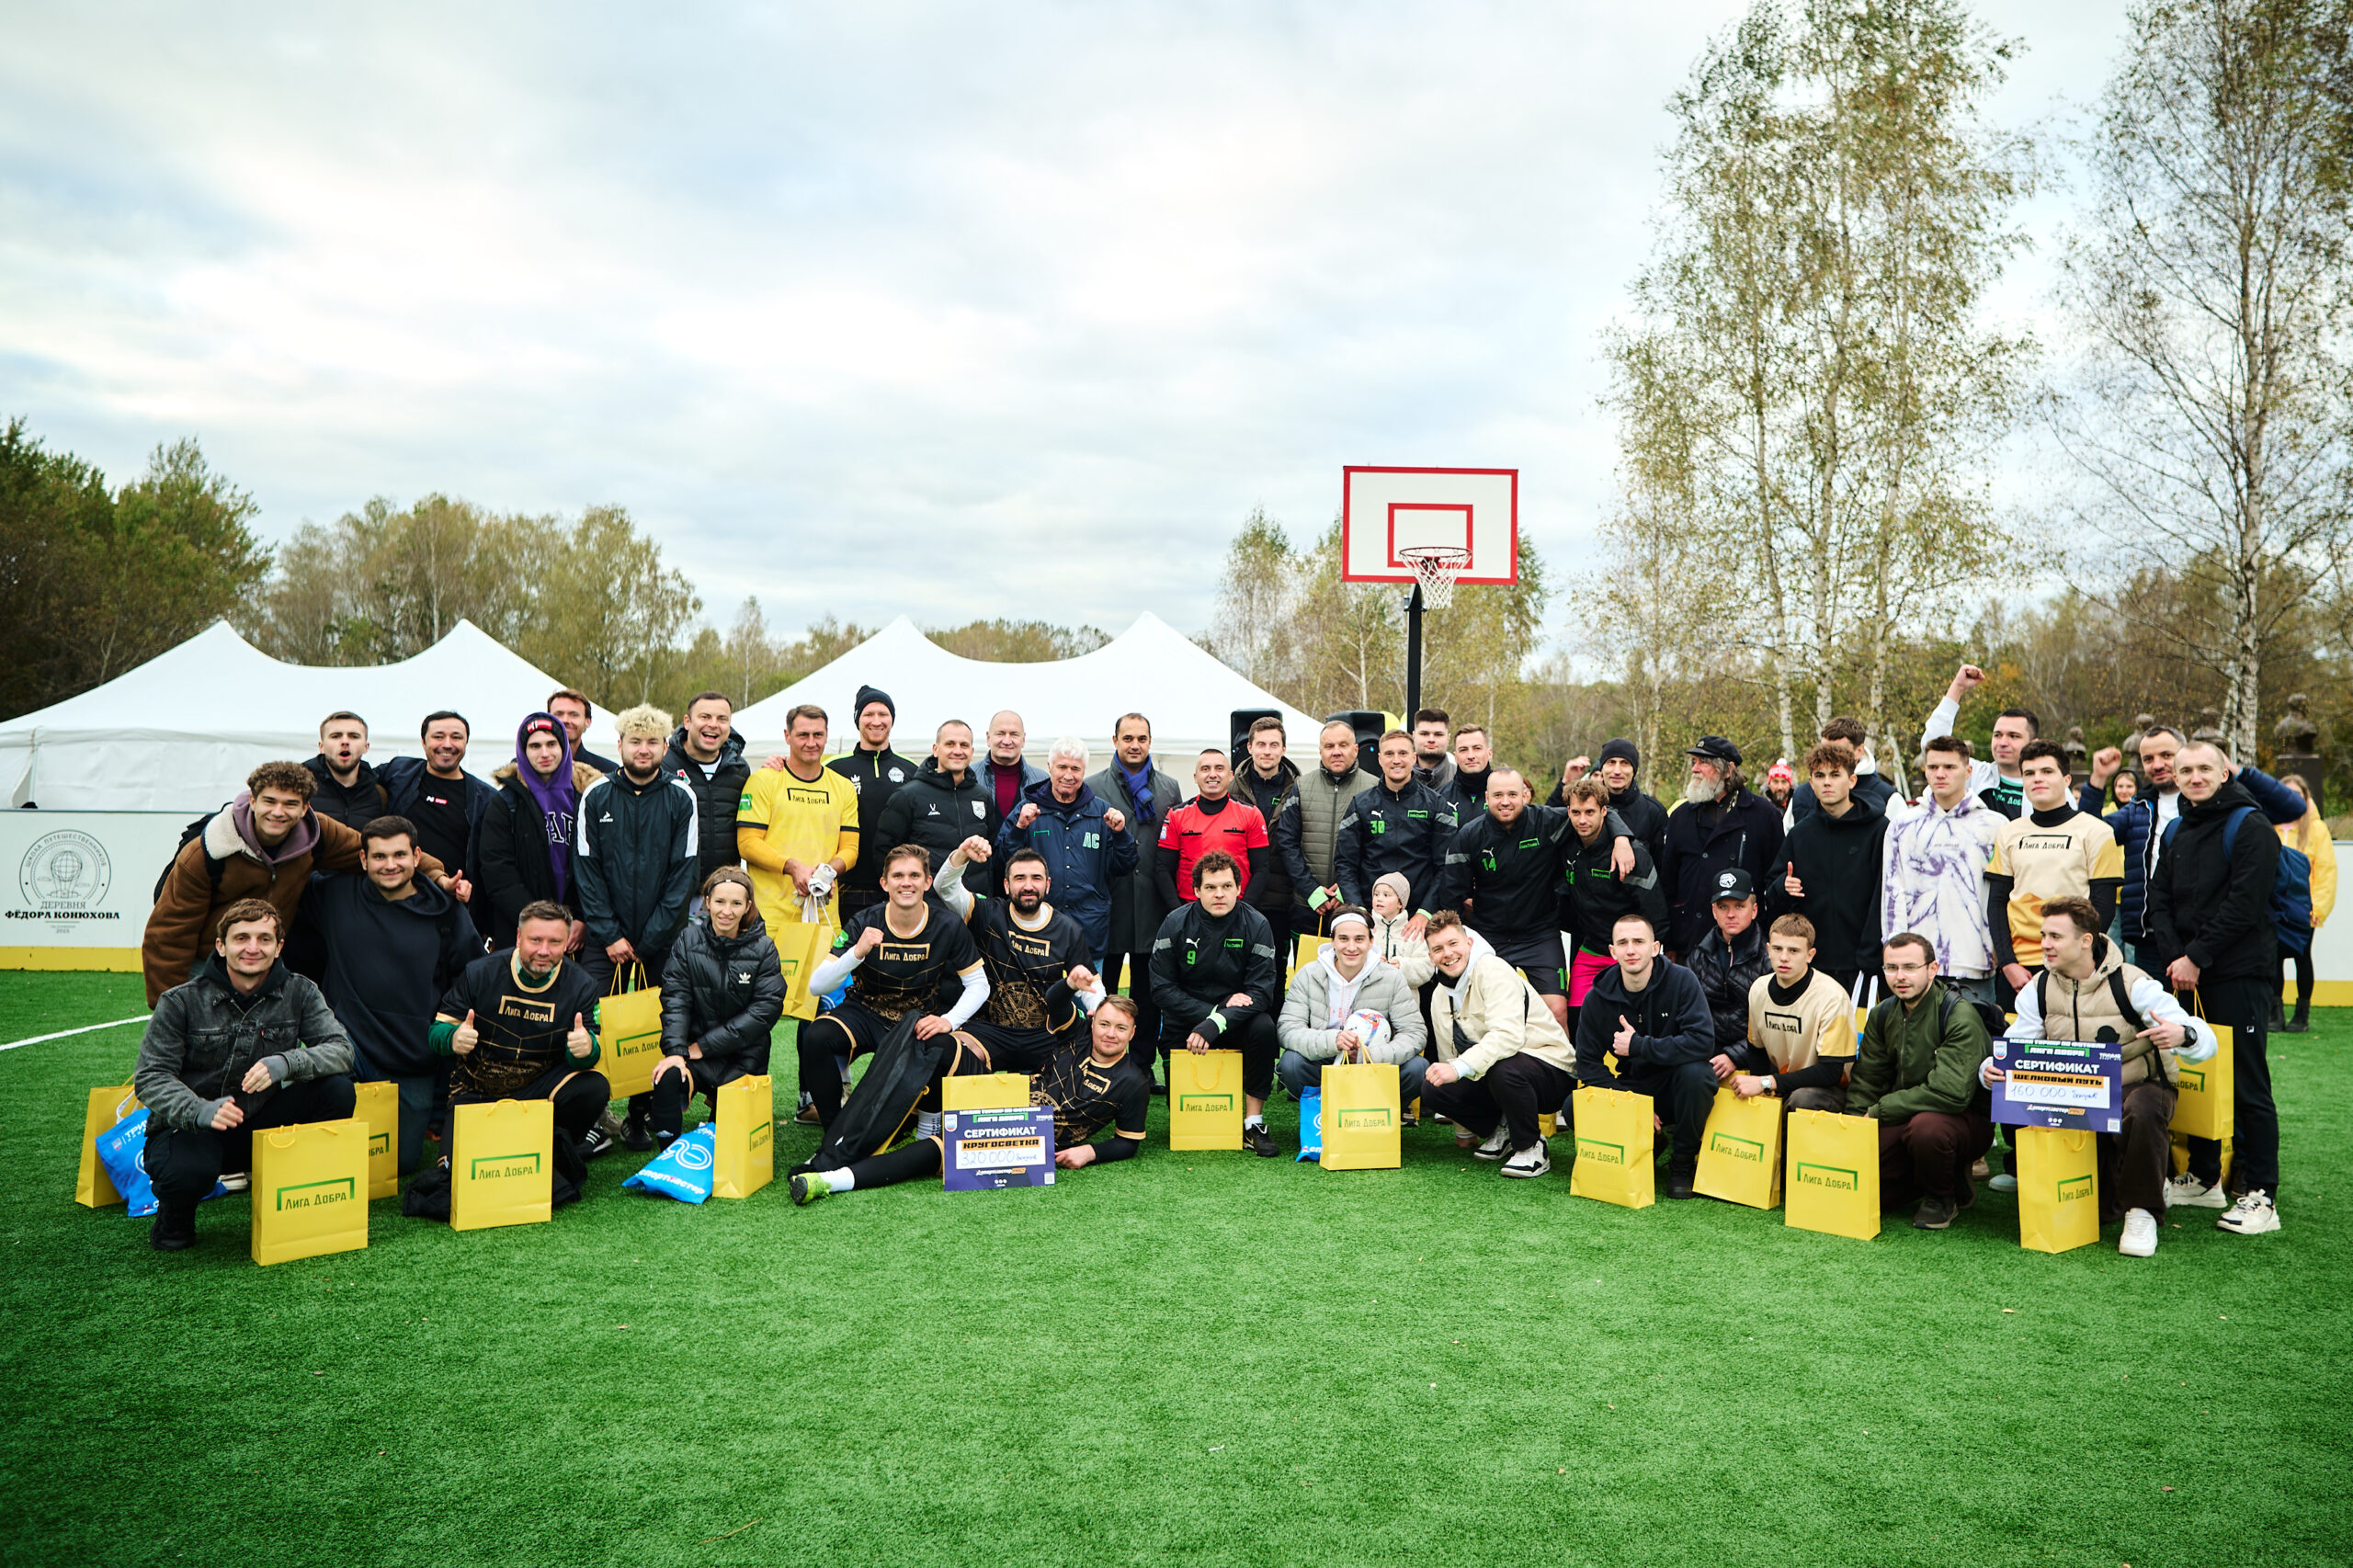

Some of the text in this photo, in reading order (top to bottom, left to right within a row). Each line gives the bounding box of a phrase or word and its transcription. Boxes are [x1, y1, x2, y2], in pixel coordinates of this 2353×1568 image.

[1370, 820, 1385, 835] 30
[1482, 858, 1496, 871] 14
[40, 901, 86, 910] ДЕРЕВНЯ
[5, 909, 120, 920] ФЁДОРА КОНЮХОВА
[1187, 949, 1197, 965] 9
[642, 1041, 660, 1052] ДОБР
[2015, 1059, 2100, 1074] СЕРТИФИКАТ
[963, 1126, 1038, 1139] СЕРТИФИКАТ
[963, 1139, 1040, 1150] КРУГОСВЕТКА
